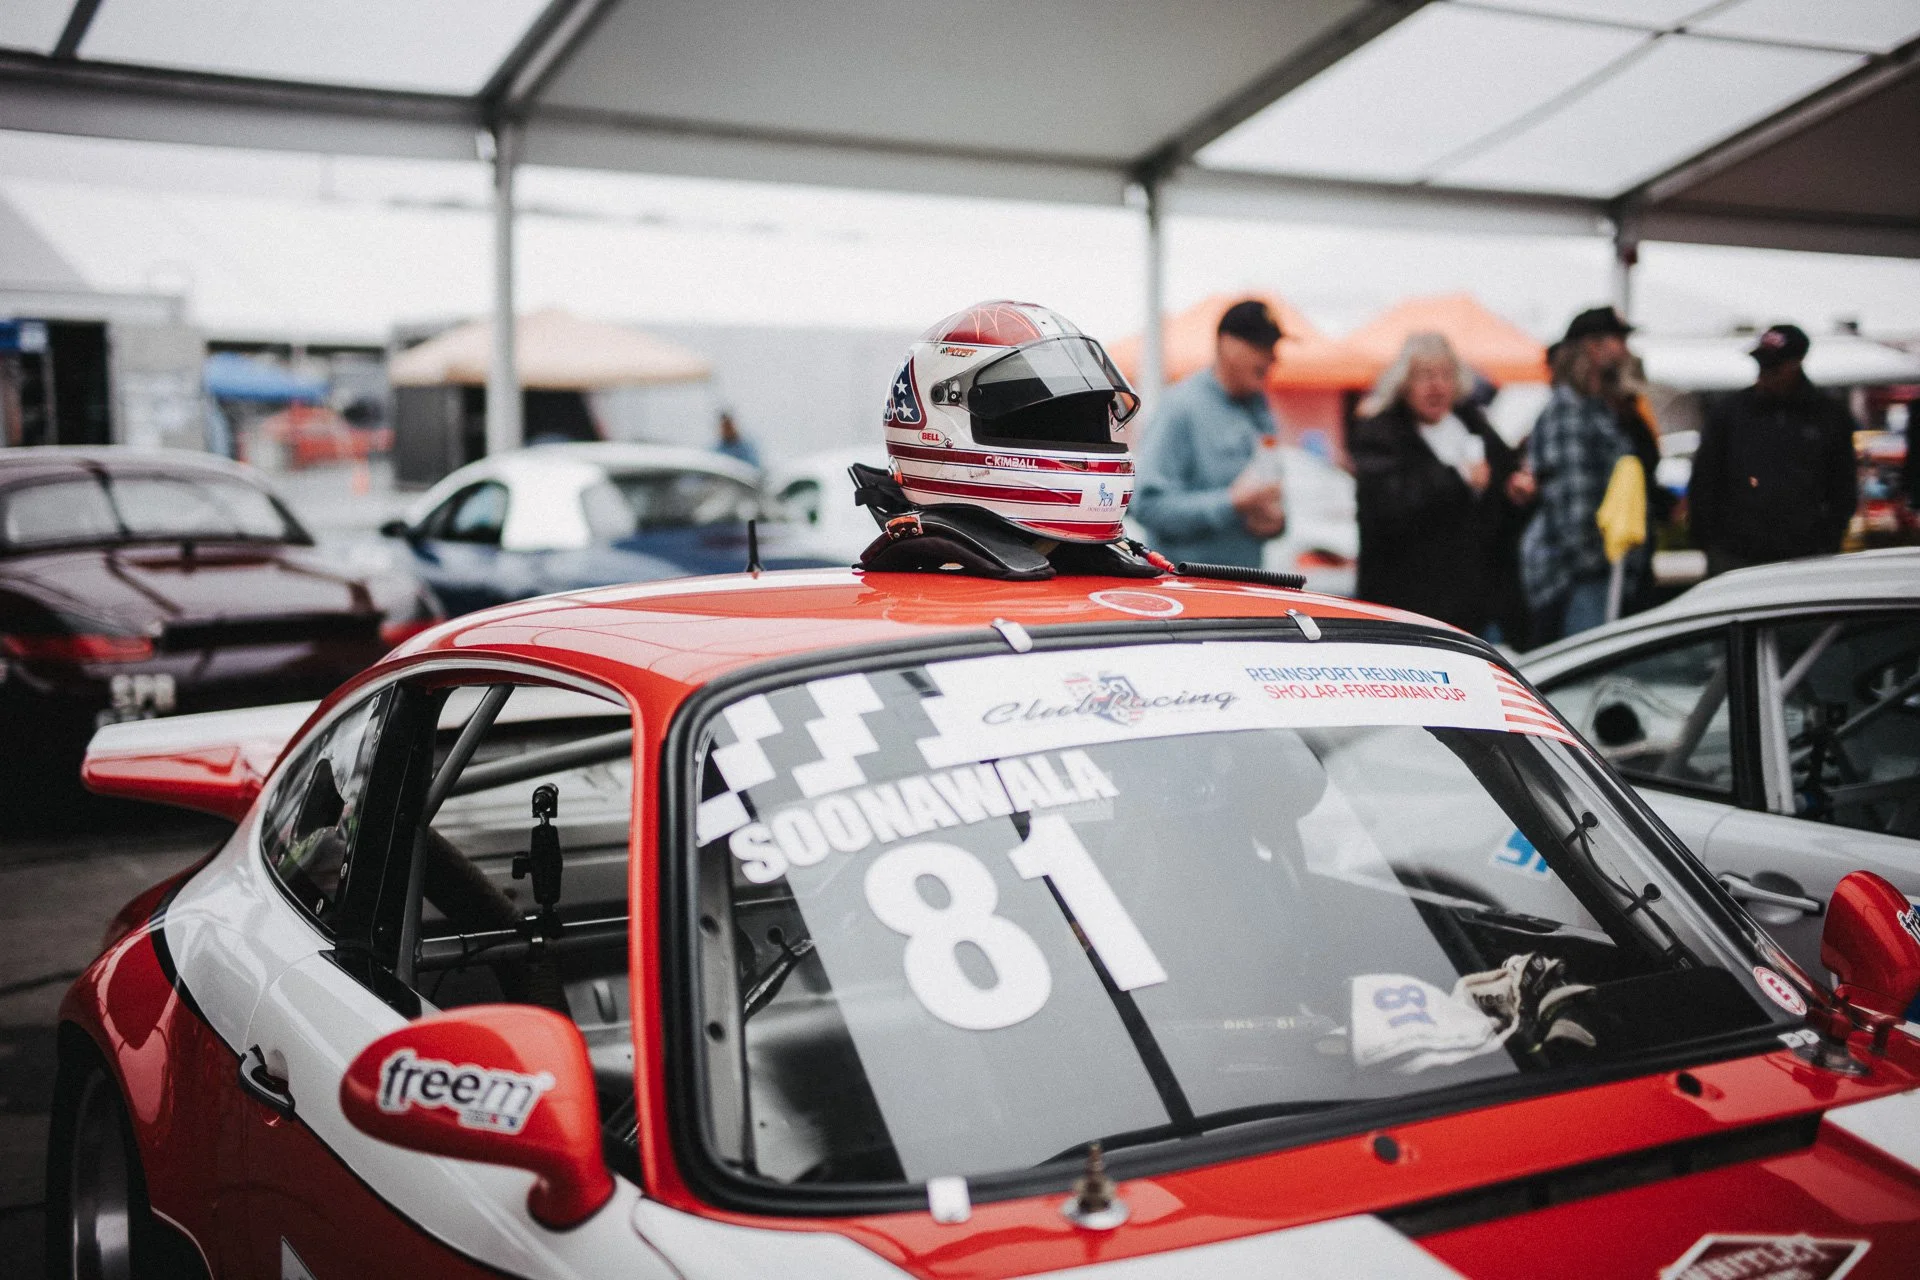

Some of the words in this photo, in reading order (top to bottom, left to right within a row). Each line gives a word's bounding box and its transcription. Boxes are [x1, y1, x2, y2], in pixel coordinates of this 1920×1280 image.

[921, 432, 940, 442] BELL
[1245, 667, 1357, 682] RENNSPORT
[1358, 668, 1437, 684] REUNION
[1263, 684, 1435, 700] SHOLAR-FRIEDMAN
[1433, 685, 1467, 701] CUP
[982, 692, 1099, 725] Club
[1106, 689, 1239, 712] Racing
[728, 749, 1121, 884] SOONAWALA
[863, 813, 1169, 1031] 81
[382, 1055, 534, 1108] freem
